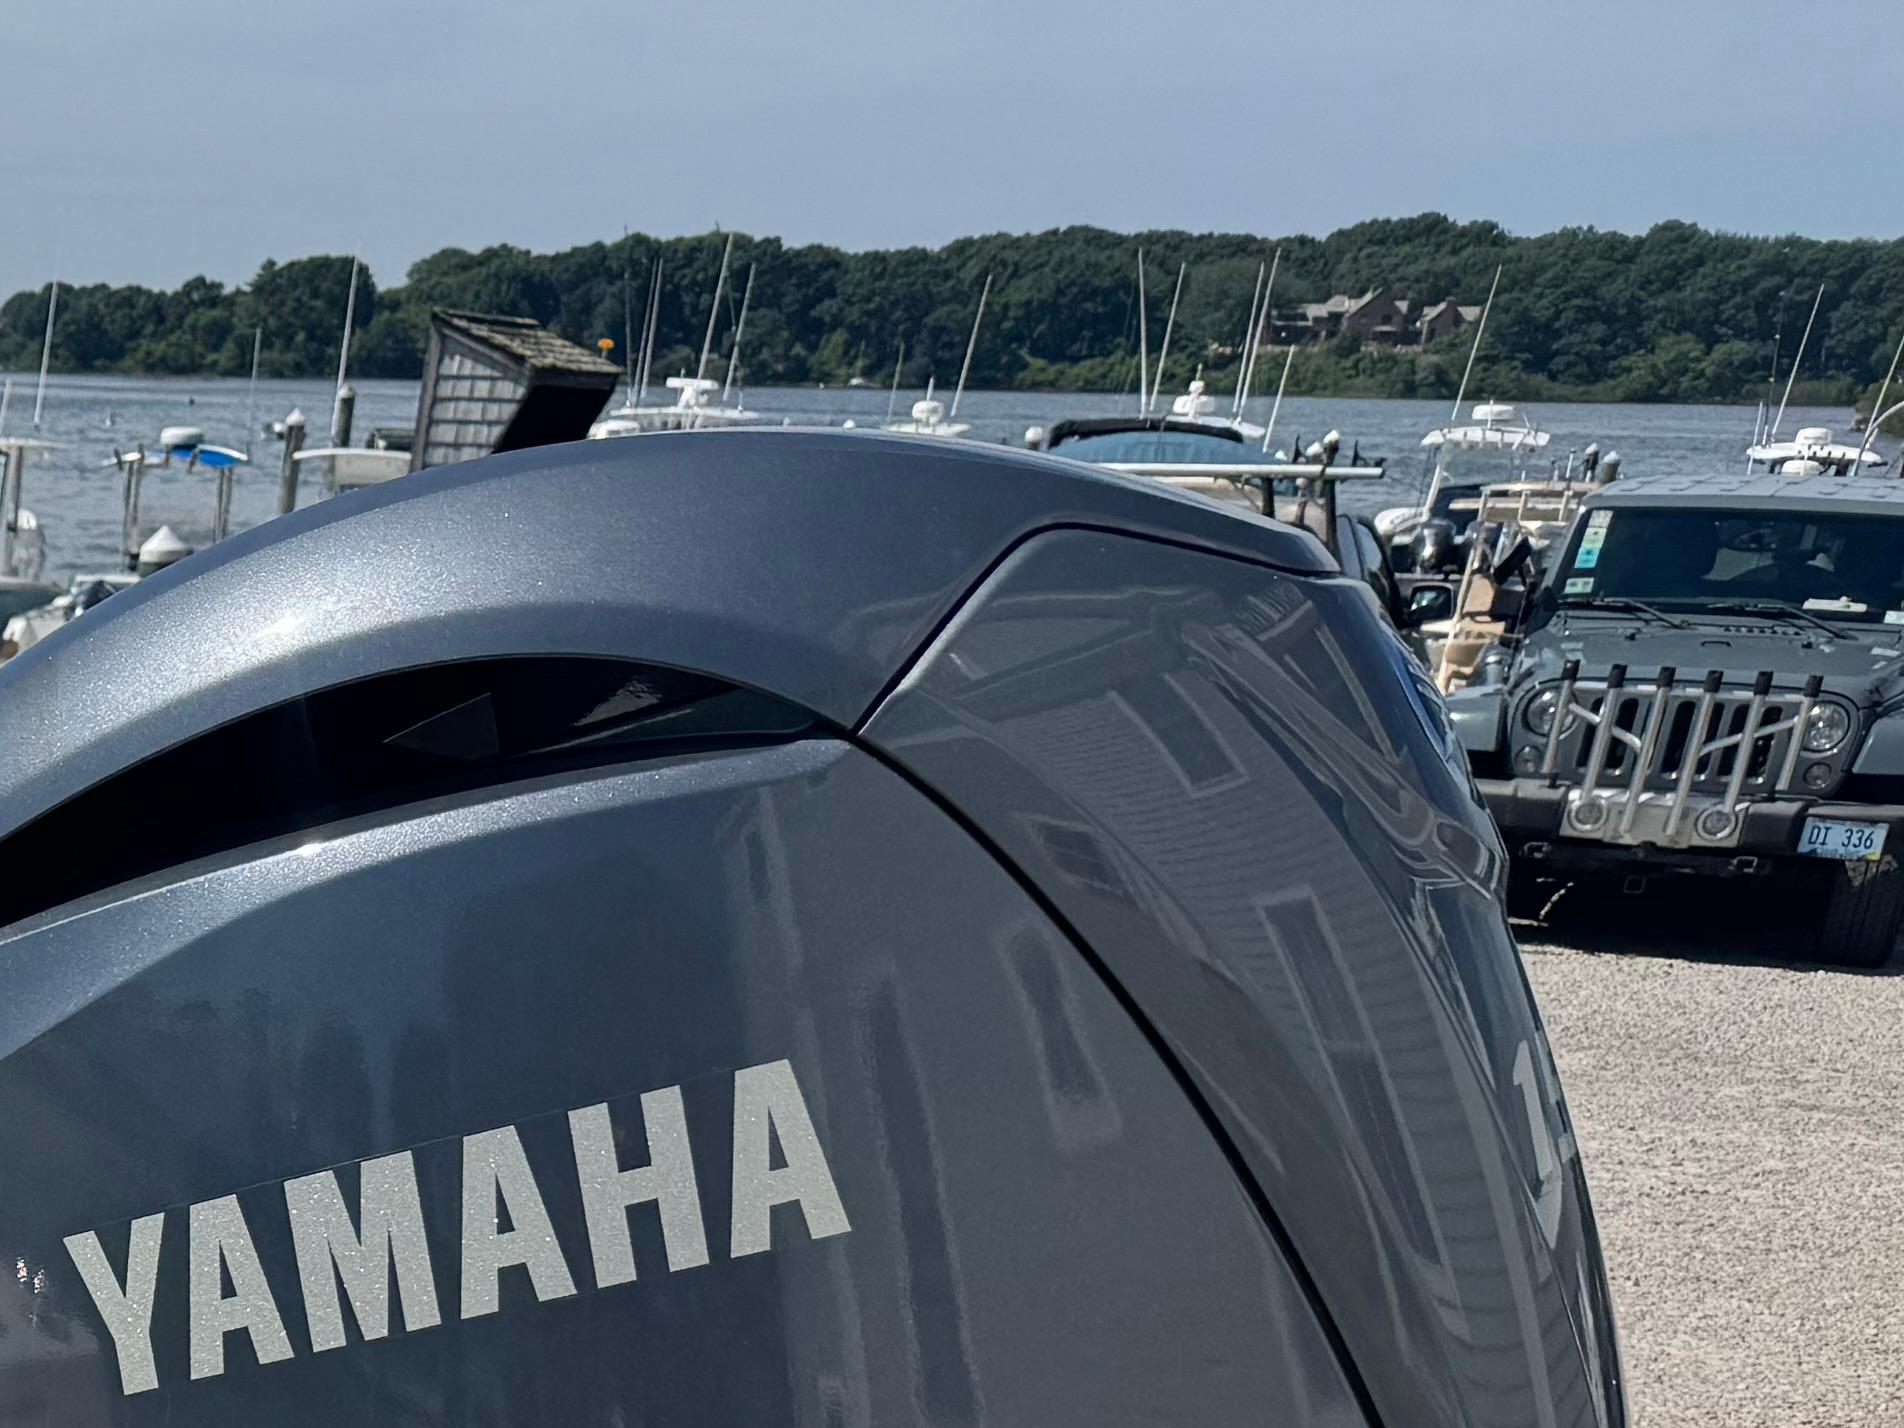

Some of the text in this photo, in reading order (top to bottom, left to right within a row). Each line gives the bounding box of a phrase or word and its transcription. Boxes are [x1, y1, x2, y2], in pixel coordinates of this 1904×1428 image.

[1808, 825, 1876, 849] DI 336
[62, 1058, 852, 1396] YAMAHA
